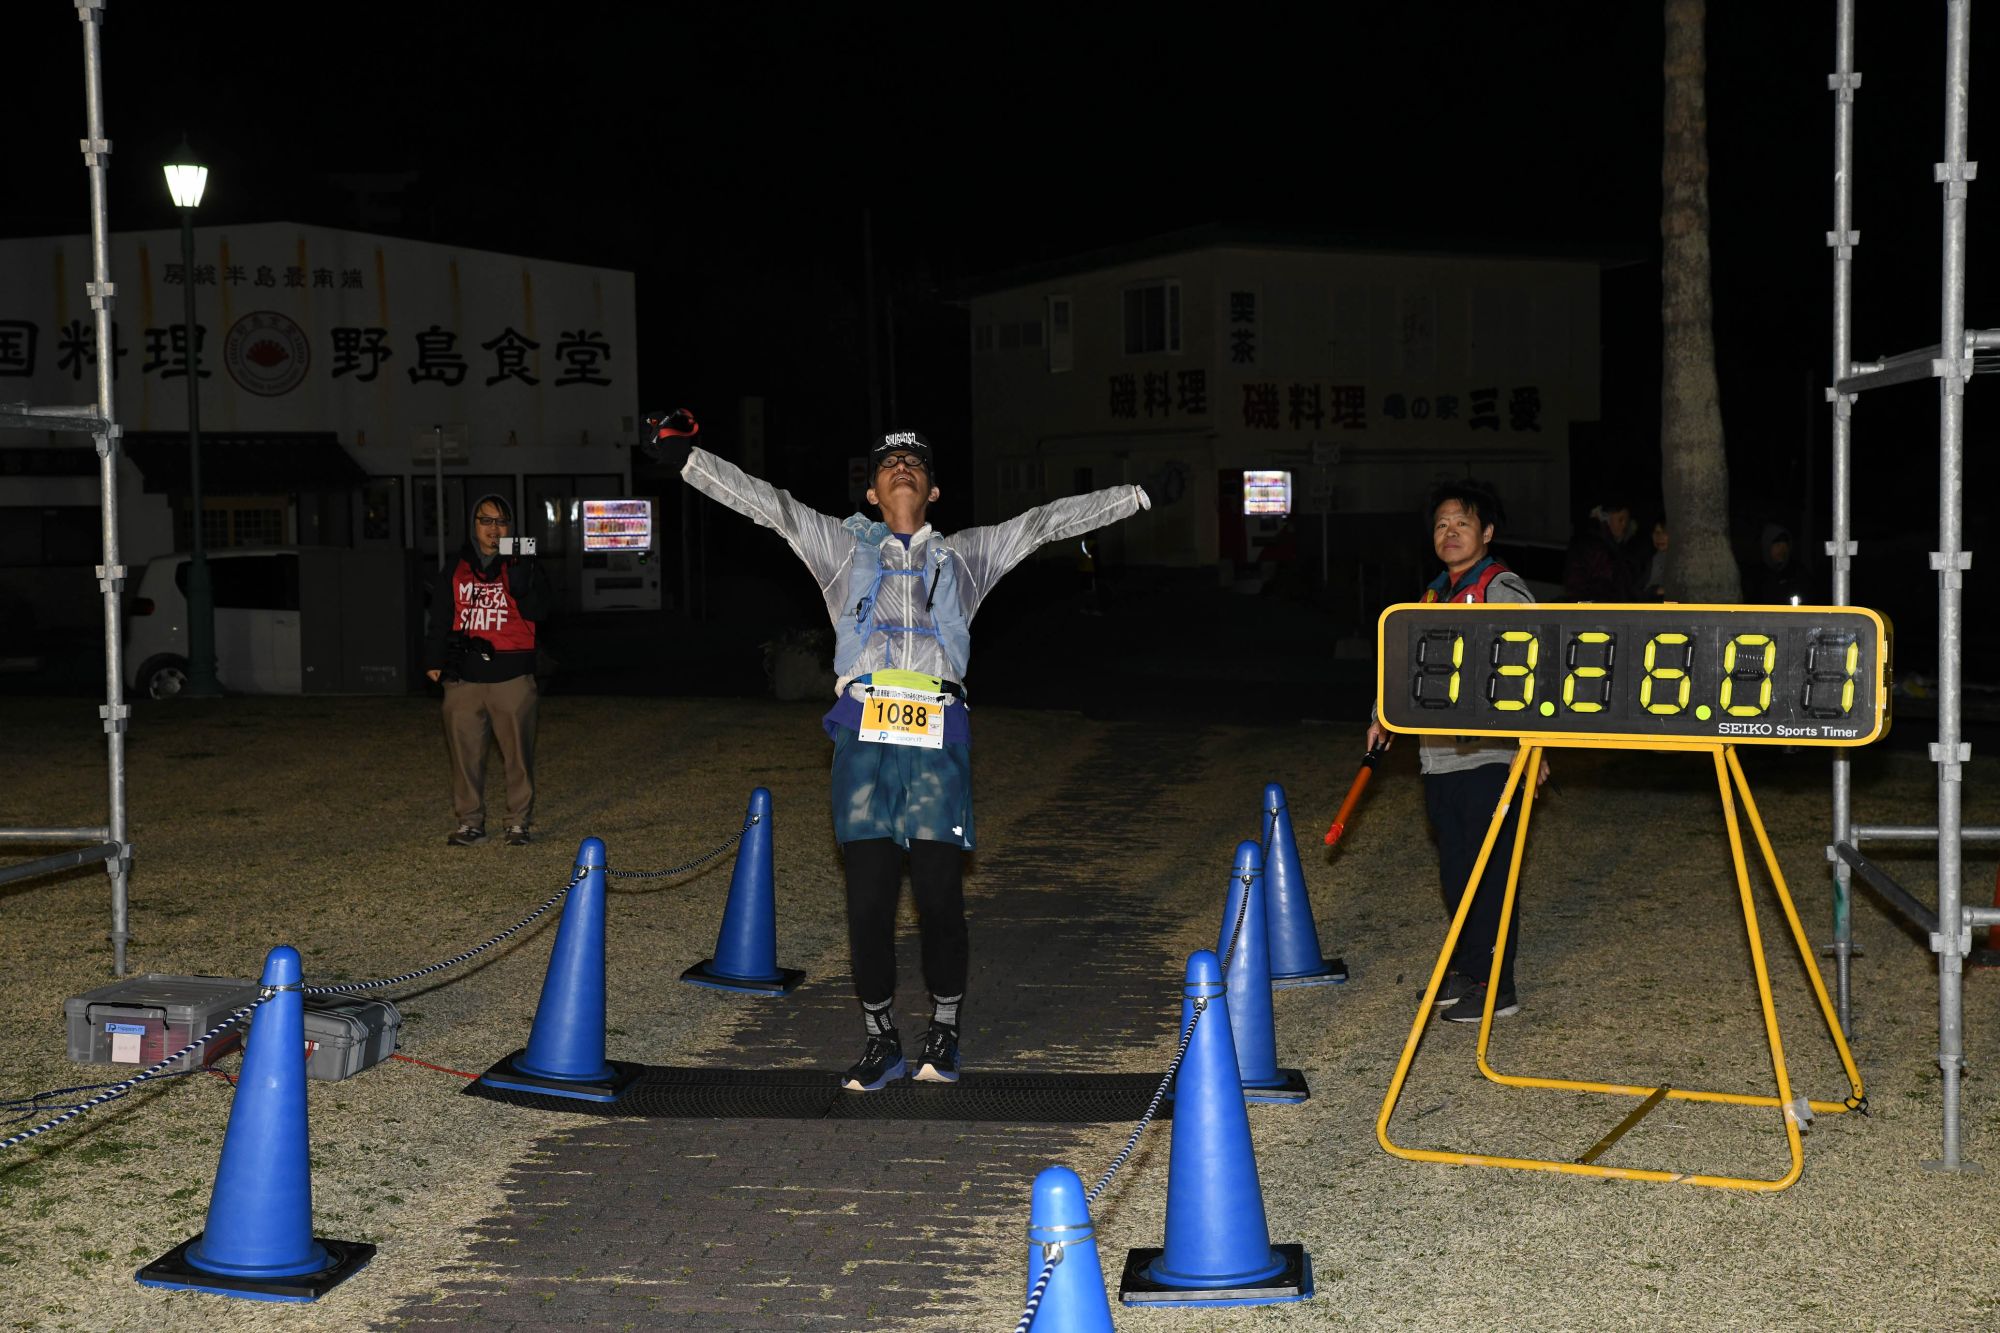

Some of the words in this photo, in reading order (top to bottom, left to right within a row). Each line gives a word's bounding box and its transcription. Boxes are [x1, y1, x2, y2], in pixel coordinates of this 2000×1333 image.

[331, 325, 612, 386] 野島食堂
[1109, 369, 1207, 420] 磯料理
[1242, 382, 1367, 431] 磯料理
[460, 608, 509, 631] STAFF
[877, 702, 927, 727] 1088
[1718, 723, 1773, 735] SEIKO
[1776, 725, 1818, 737] Sports
[1821, 726, 1858, 738] Timer
